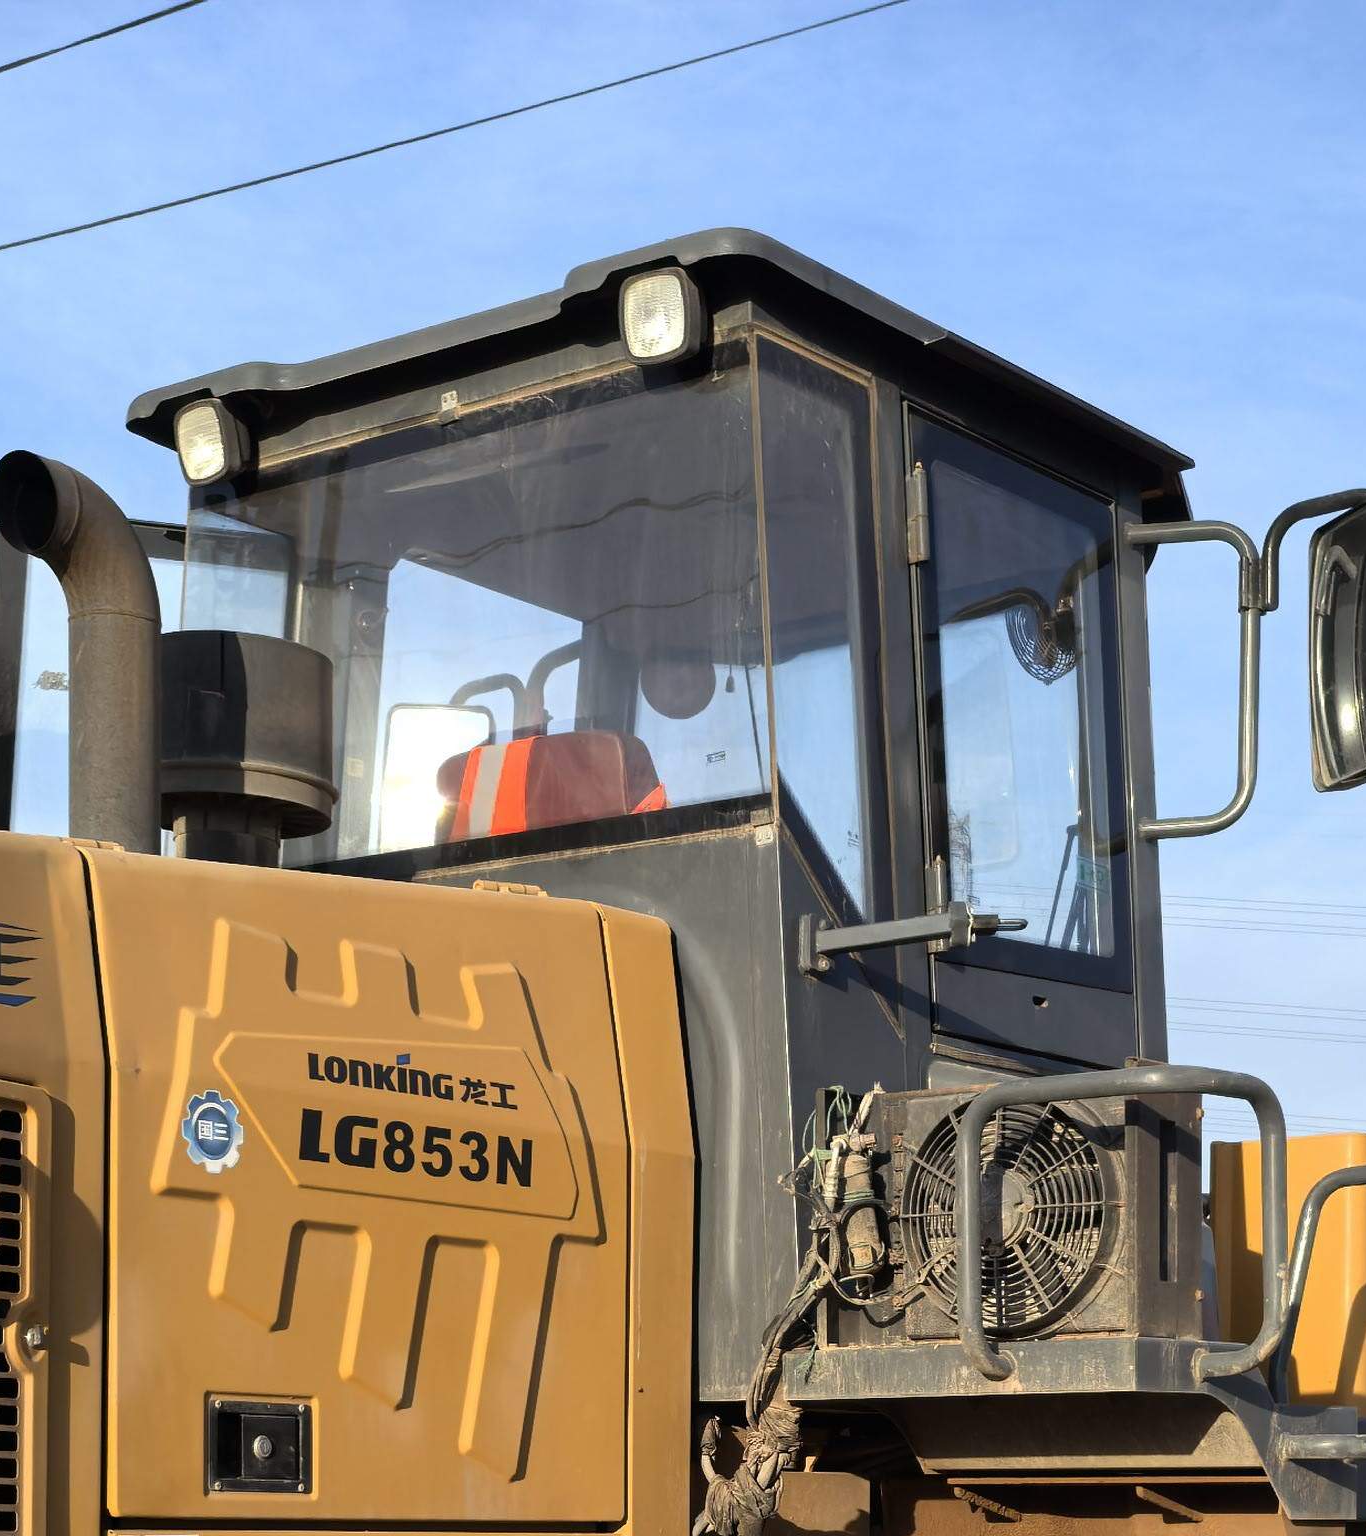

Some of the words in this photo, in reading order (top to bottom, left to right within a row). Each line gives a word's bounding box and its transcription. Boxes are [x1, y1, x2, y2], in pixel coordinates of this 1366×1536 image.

[307, 1052, 454, 1101] LONKING
[459, 1076, 518, 1110] 龙工
[298, 1108, 533, 1187] LG853N
